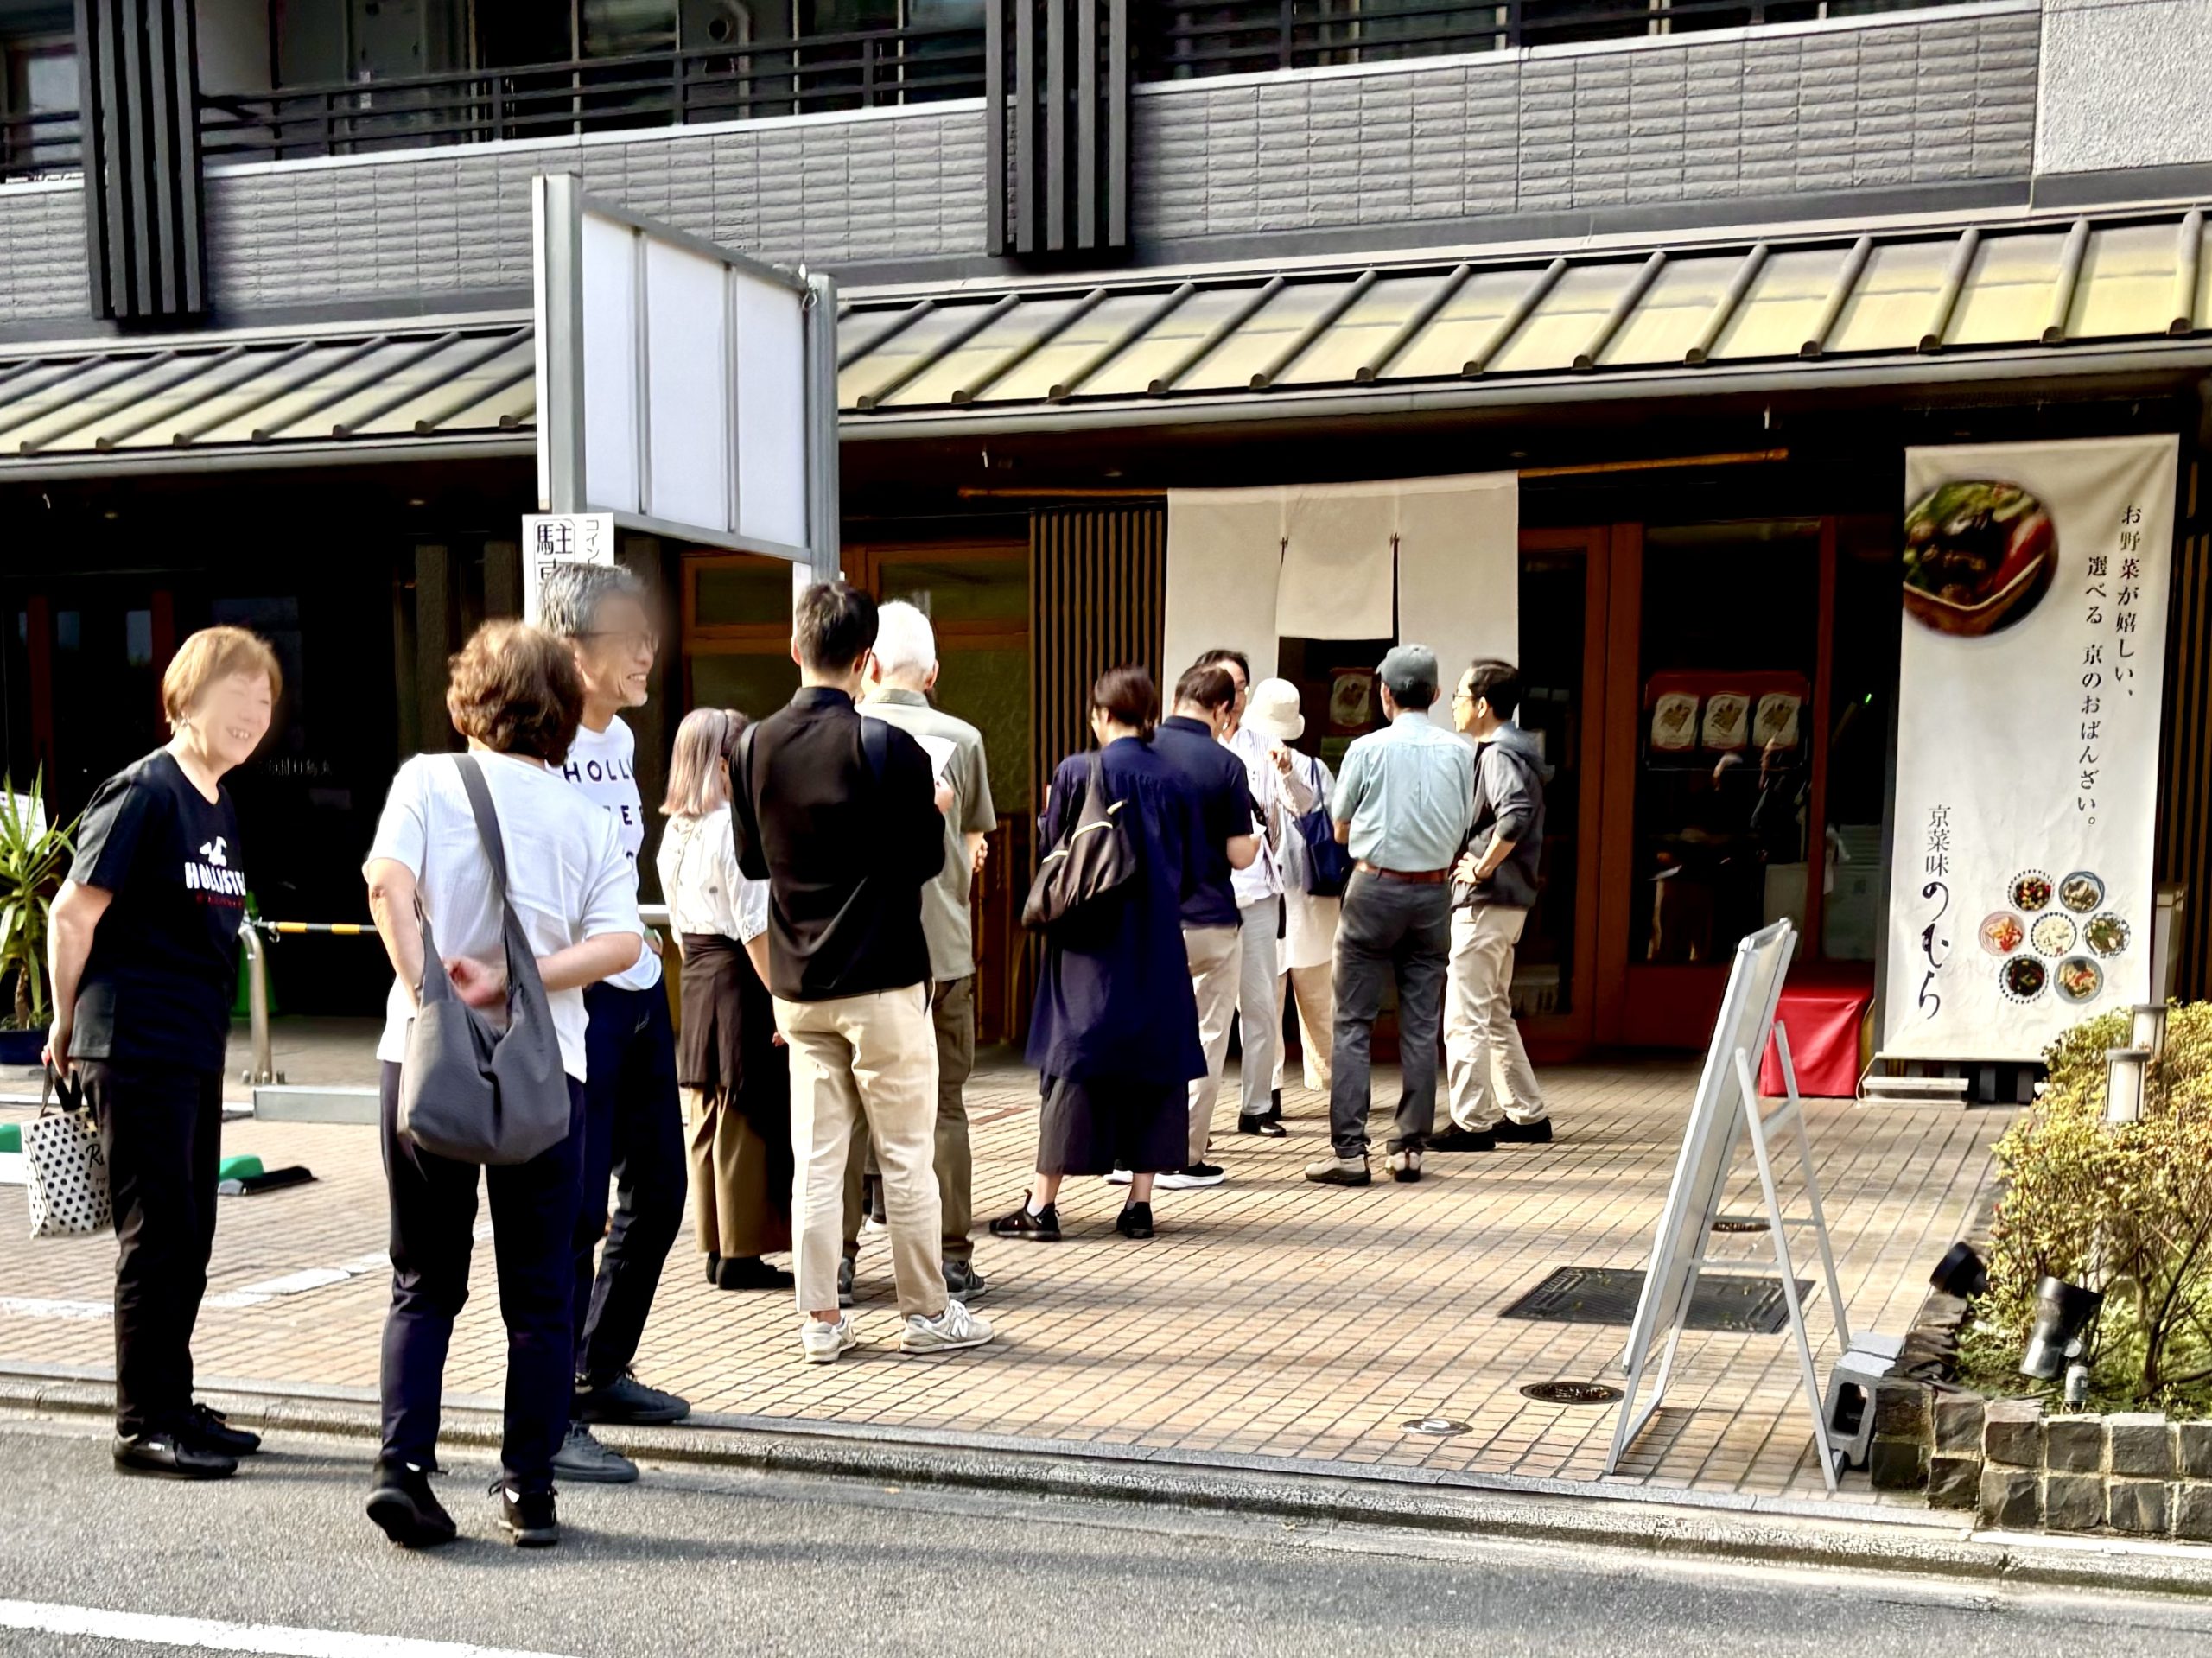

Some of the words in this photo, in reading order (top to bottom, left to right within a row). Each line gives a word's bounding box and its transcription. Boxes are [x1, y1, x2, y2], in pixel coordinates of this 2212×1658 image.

[2085, 556, 2108, 625] 選べる
[2115, 505, 2142, 697] お野菜が嬉しい、
